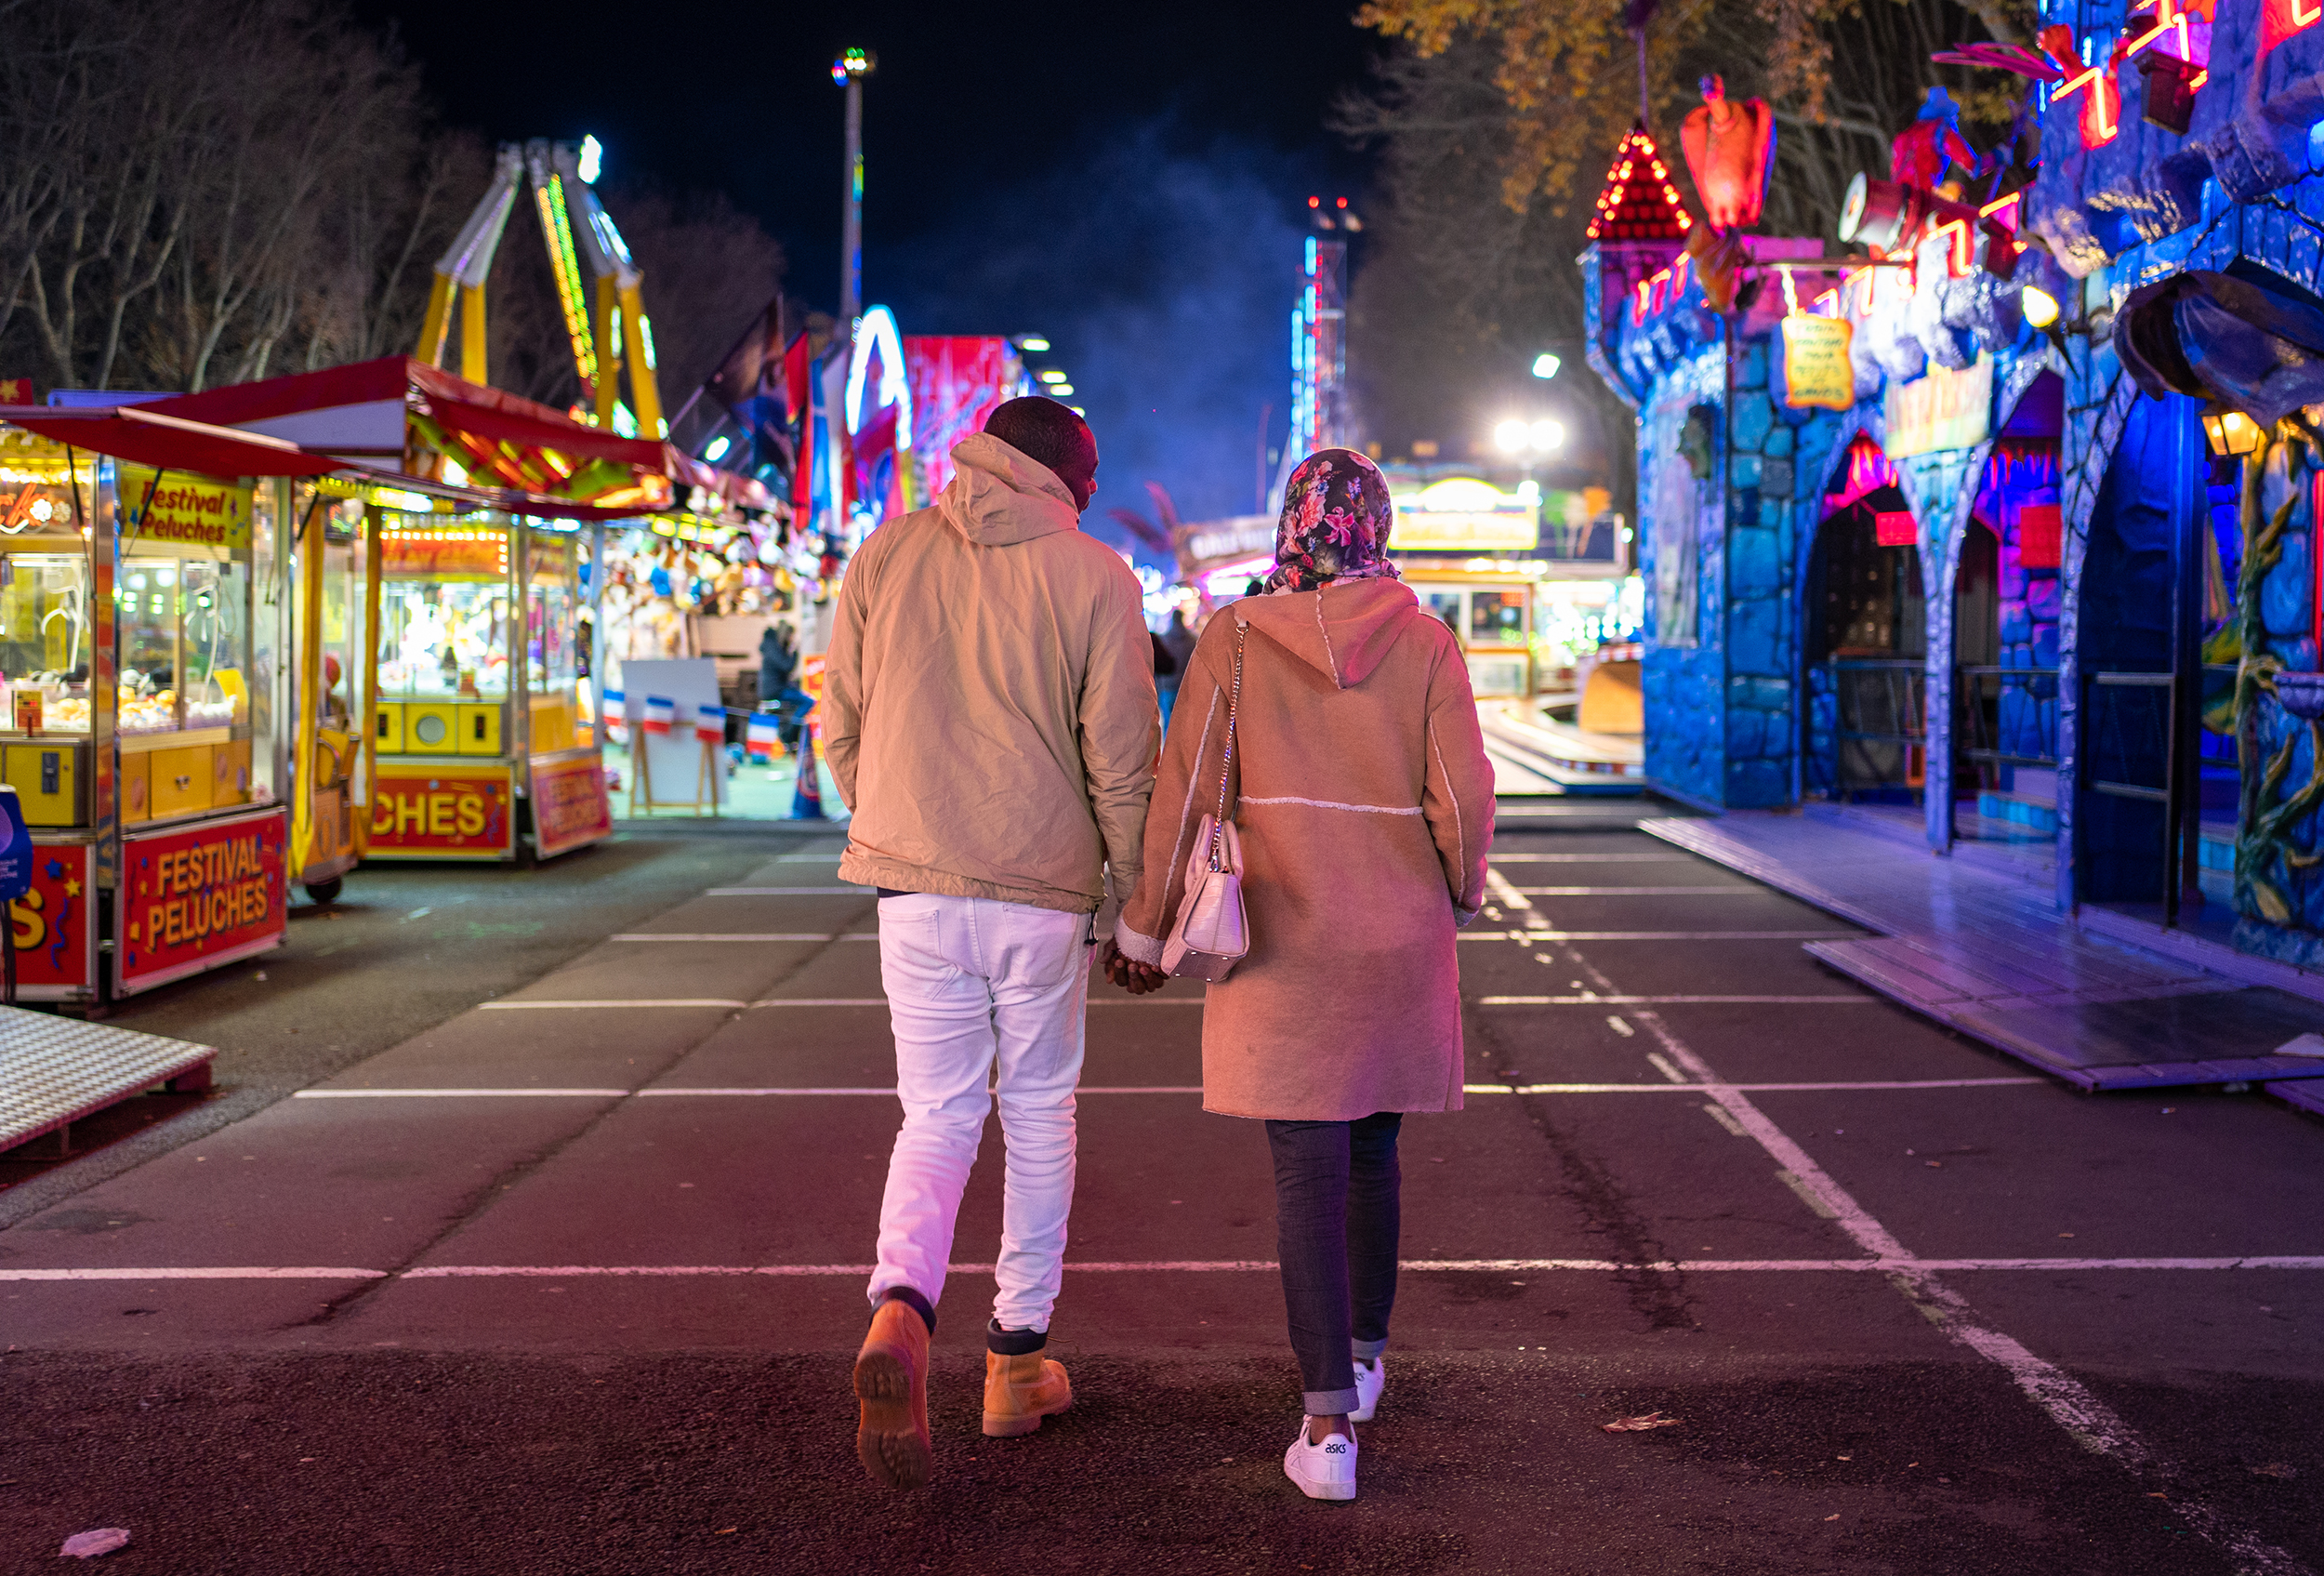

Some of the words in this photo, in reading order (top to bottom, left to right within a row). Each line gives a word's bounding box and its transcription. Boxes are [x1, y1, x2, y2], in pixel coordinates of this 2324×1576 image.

[139, 510, 226, 541] Peluches
[156, 835, 263, 899] FESTIVAL
[148, 878, 269, 952] PELUCHES
